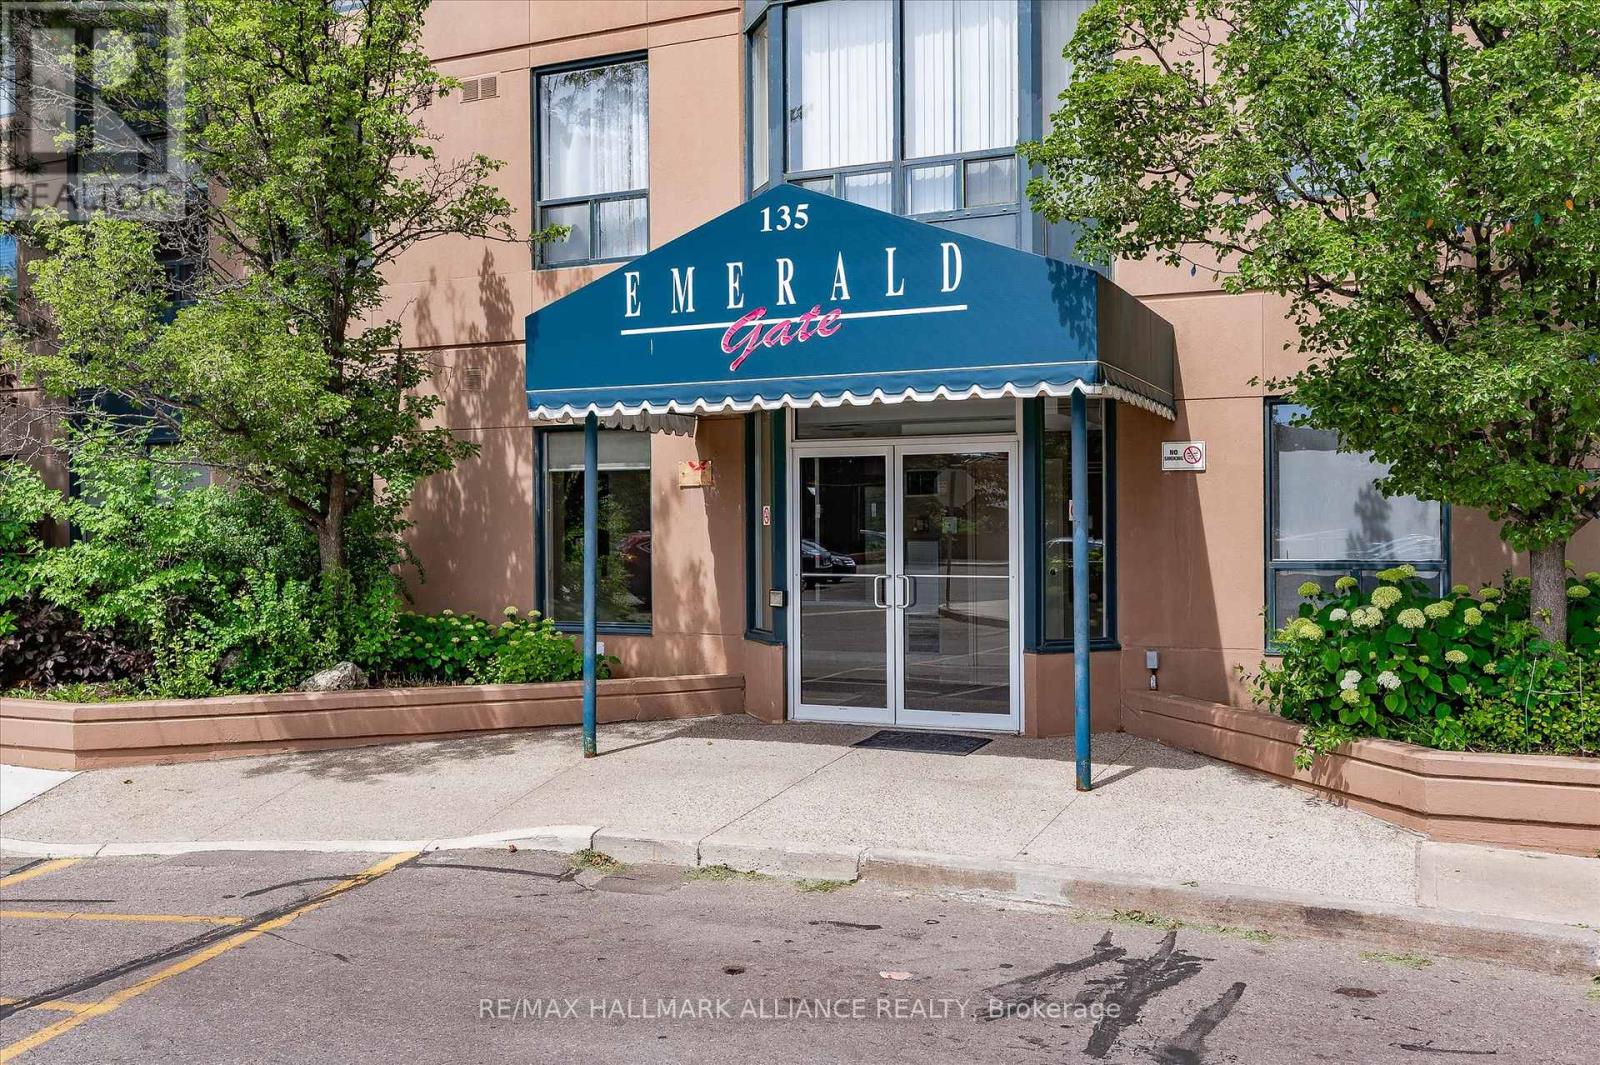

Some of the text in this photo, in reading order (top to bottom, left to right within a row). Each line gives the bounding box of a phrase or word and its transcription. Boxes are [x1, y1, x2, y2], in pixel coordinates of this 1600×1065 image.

[760, 203, 809, 232] 135
[624, 242, 963, 318] EMERALD
[720, 304, 842, 372] Gate
